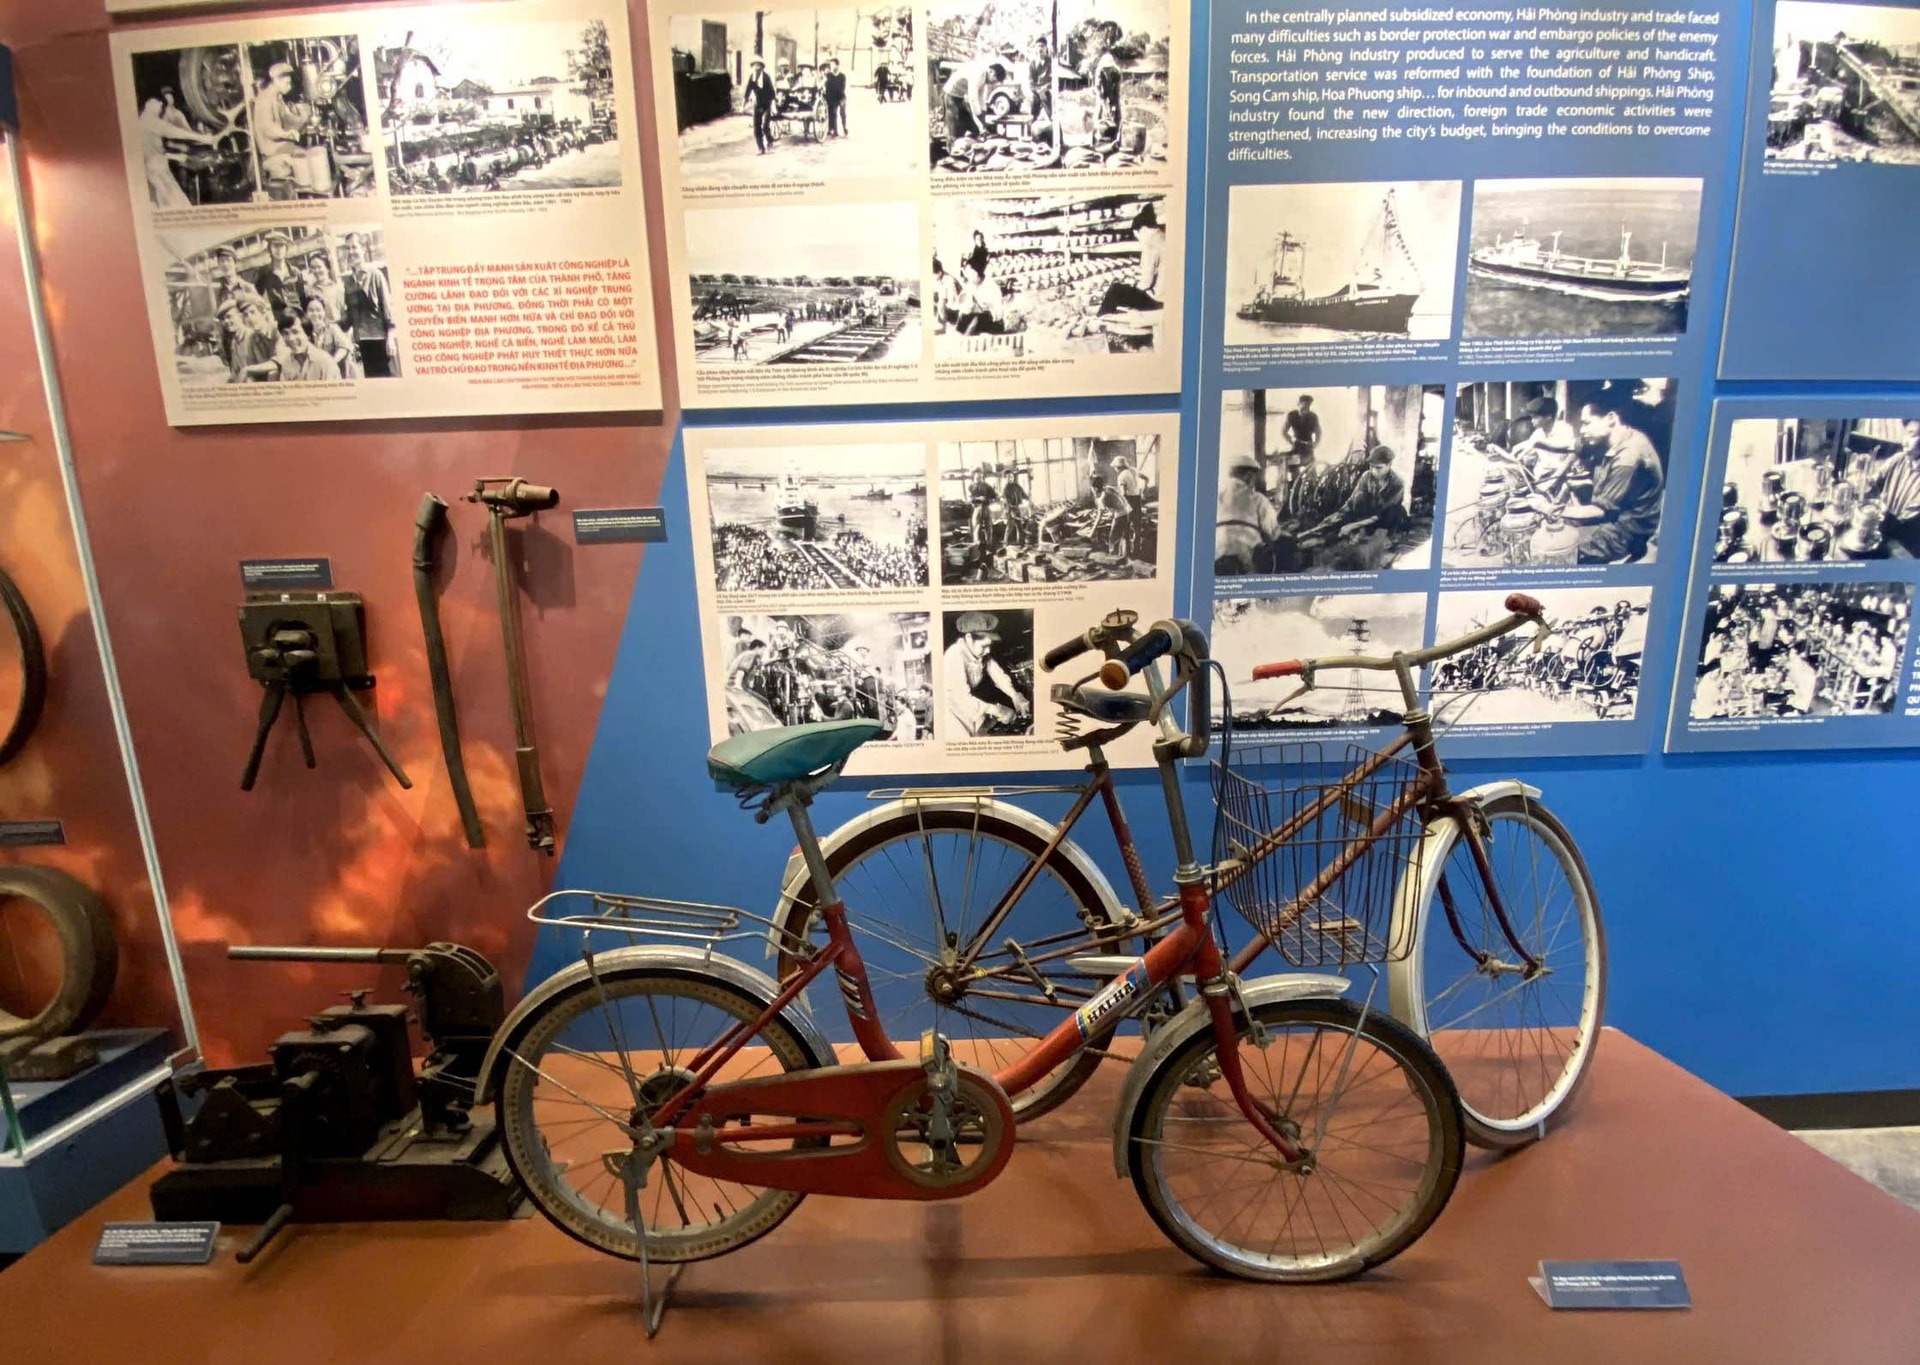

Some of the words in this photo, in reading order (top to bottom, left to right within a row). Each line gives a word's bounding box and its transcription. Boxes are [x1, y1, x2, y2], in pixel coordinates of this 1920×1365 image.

[1246, 11, 1257, 23] In
[1259, 9, 1280, 23] the
[1282, 8, 1335, 25] centrally
[1336, 8, 1387, 25] planned
[1389, 7, 1454, 21] subsidized
[1455, 10, 1513, 23] economy,
[1538, 8, 1577, 24] Phòng
[1579, 8, 1629, 24] industry
[1630, 10, 1653, 22] and
[1655, 10, 1687, 23] trade
[1687, 10, 1719, 24] faced
[1231, 33, 1265, 46] many
[1267, 29, 1330, 43] difficulties
[1333, 28, 1361, 42] such
[1363, 31, 1377, 41] as
[1379, 27, 1421, 41] border
[1422, 28, 1486, 43] protection
[1488, 30, 1511, 40] war
[1513, 27, 1537, 40] and
[1539, 27, 1593, 43] embargo
[1595, 27, 1640, 43] policies
[1642, 28, 1656, 41] of
[1657, 29, 1677, 41] the
[1678, 32, 1718, 45] enemy
[1230, 50, 1269, 63] forces.
[1303, 48, 1343, 65] Phòng
[1349, 47, 1400, 63] industry
[1406, 46, 1465, 63] produced
[1471, 47, 1484, 60] to
[1491, 49, 1523, 59] serve
[1529, 46, 1550, 59] the
[1555, 47, 1620, 62] agriculture
[1626, 47, 1649, 60] and
[1655, 47, 1716, 61] handicraft.
[1230, 69, 1318, 85] Transportation
[1325, 68, 1367, 81] service
[1374, 70, 1397, 80] was
[1404, 65, 1460, 79] reformed
[1466, 65, 1493, 78] with
[1500, 65, 1520, 78] the
[1526, 65, 1592, 78] foundation
[1598, 65, 1612, 78] of
[1643, 66, 1681, 82] Phòng
[1687, 67, 1715, 82] Ship,
[1229, 90, 1260, 105] Song
[1262, 89, 1289, 102] Cam
[1292, 88, 1319, 103] ship,
[1321, 88, 1345, 100] Hoa
[1347, 87, 1395, 102] Phuong
[1437, 85, 1455, 98] for
[1455, 84, 1507, 98] inbound
[1508, 84, 1532, 97] and
[1533, 84, 1593, 97] outbound
[1594, 84, 1654, 100] shippings.
[1676, 85, 1714, 101] Phòng
[1229, 109, 1279, 124] industry
[1288, 107, 1324, 120] found
[1333, 106, 1354, 120] the
[1362, 109, 1389, 119] new
[1397, 105, 1455, 119] direction,
[1463, 104, 1507, 120] foreign
[1516, 103, 1548, 116] trade
[1556, 104, 1615, 116] economic
[1623, 104, 1676, 116] activities
[1684, 107, 1712, 117] were
[1228, 127, 1311, 144] strengthened,
[1316, 126, 1377, 141] increasing
[1382, 125, 1402, 138] the
[1440, 123, 1487, 139] budget,
[1491, 123, 1543, 138] bringing
[1547, 122, 1567, 135] the
[1571, 122, 1633, 135] conditions
[1637, 124, 1650, 135] to
[1653, 125, 1711, 136] overcome
[1227, 147, 1292, 160] difficulties.
